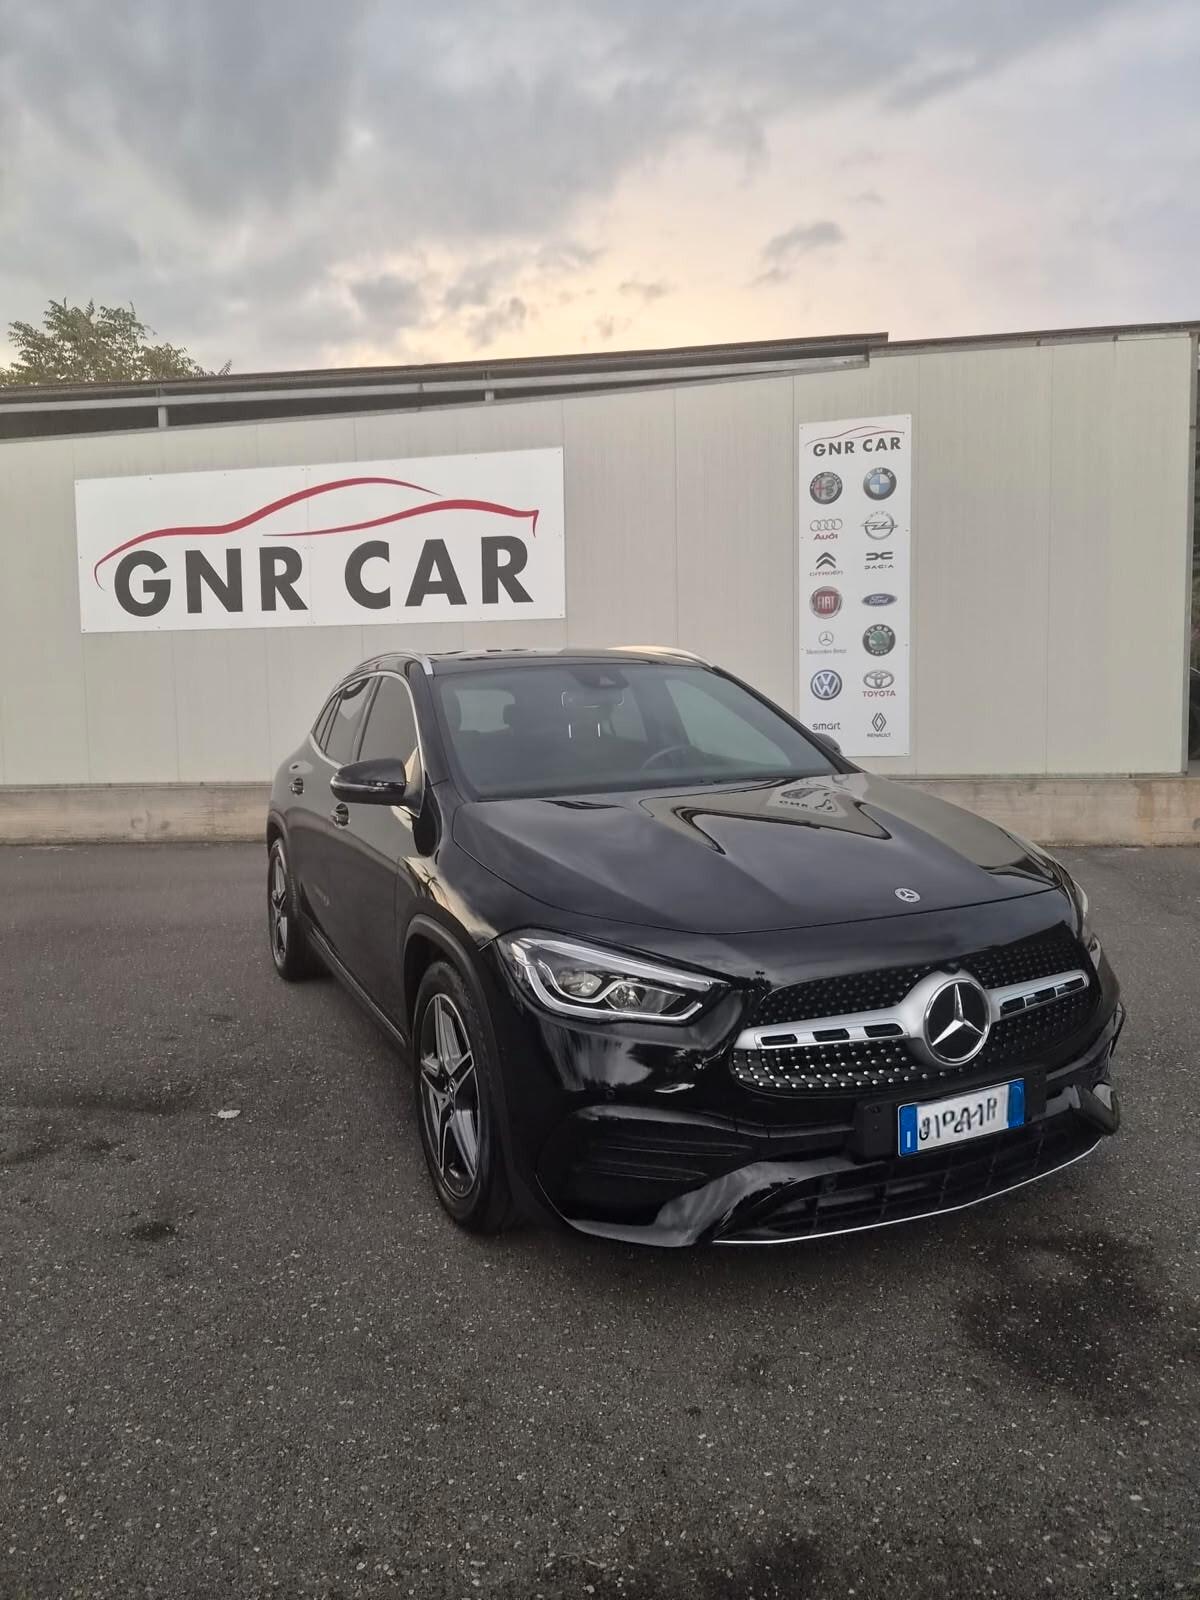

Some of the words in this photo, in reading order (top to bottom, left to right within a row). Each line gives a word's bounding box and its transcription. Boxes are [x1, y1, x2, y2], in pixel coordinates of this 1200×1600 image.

[813, 441, 855, 457] GNR
[862, 437, 902, 452] CAR
[814, 532, 838, 541] Audi
[114, 546, 308, 617] GNR
[344, 535, 534, 610] CAR
[818, 596, 835, 609] FIAT
[812, 722, 841, 731] smart
